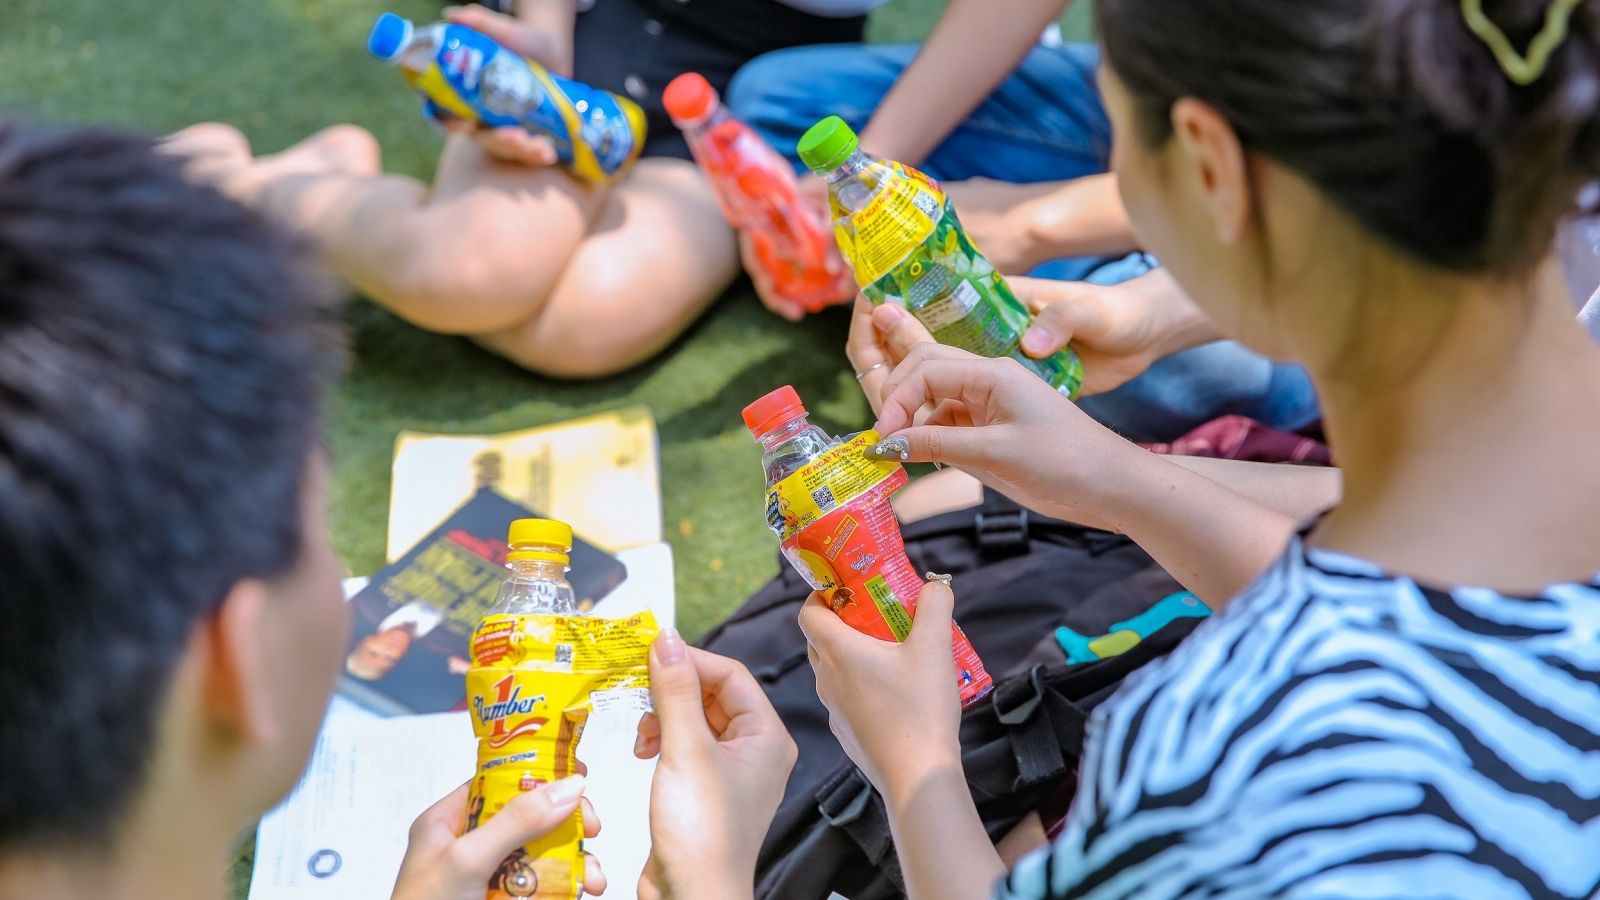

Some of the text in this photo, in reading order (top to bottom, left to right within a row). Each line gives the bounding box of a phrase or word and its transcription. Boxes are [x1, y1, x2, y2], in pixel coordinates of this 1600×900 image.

[812, 454, 832, 471] NGAY
[473, 684, 545, 727] Number
[509, 751, 537, 763] DRINK
